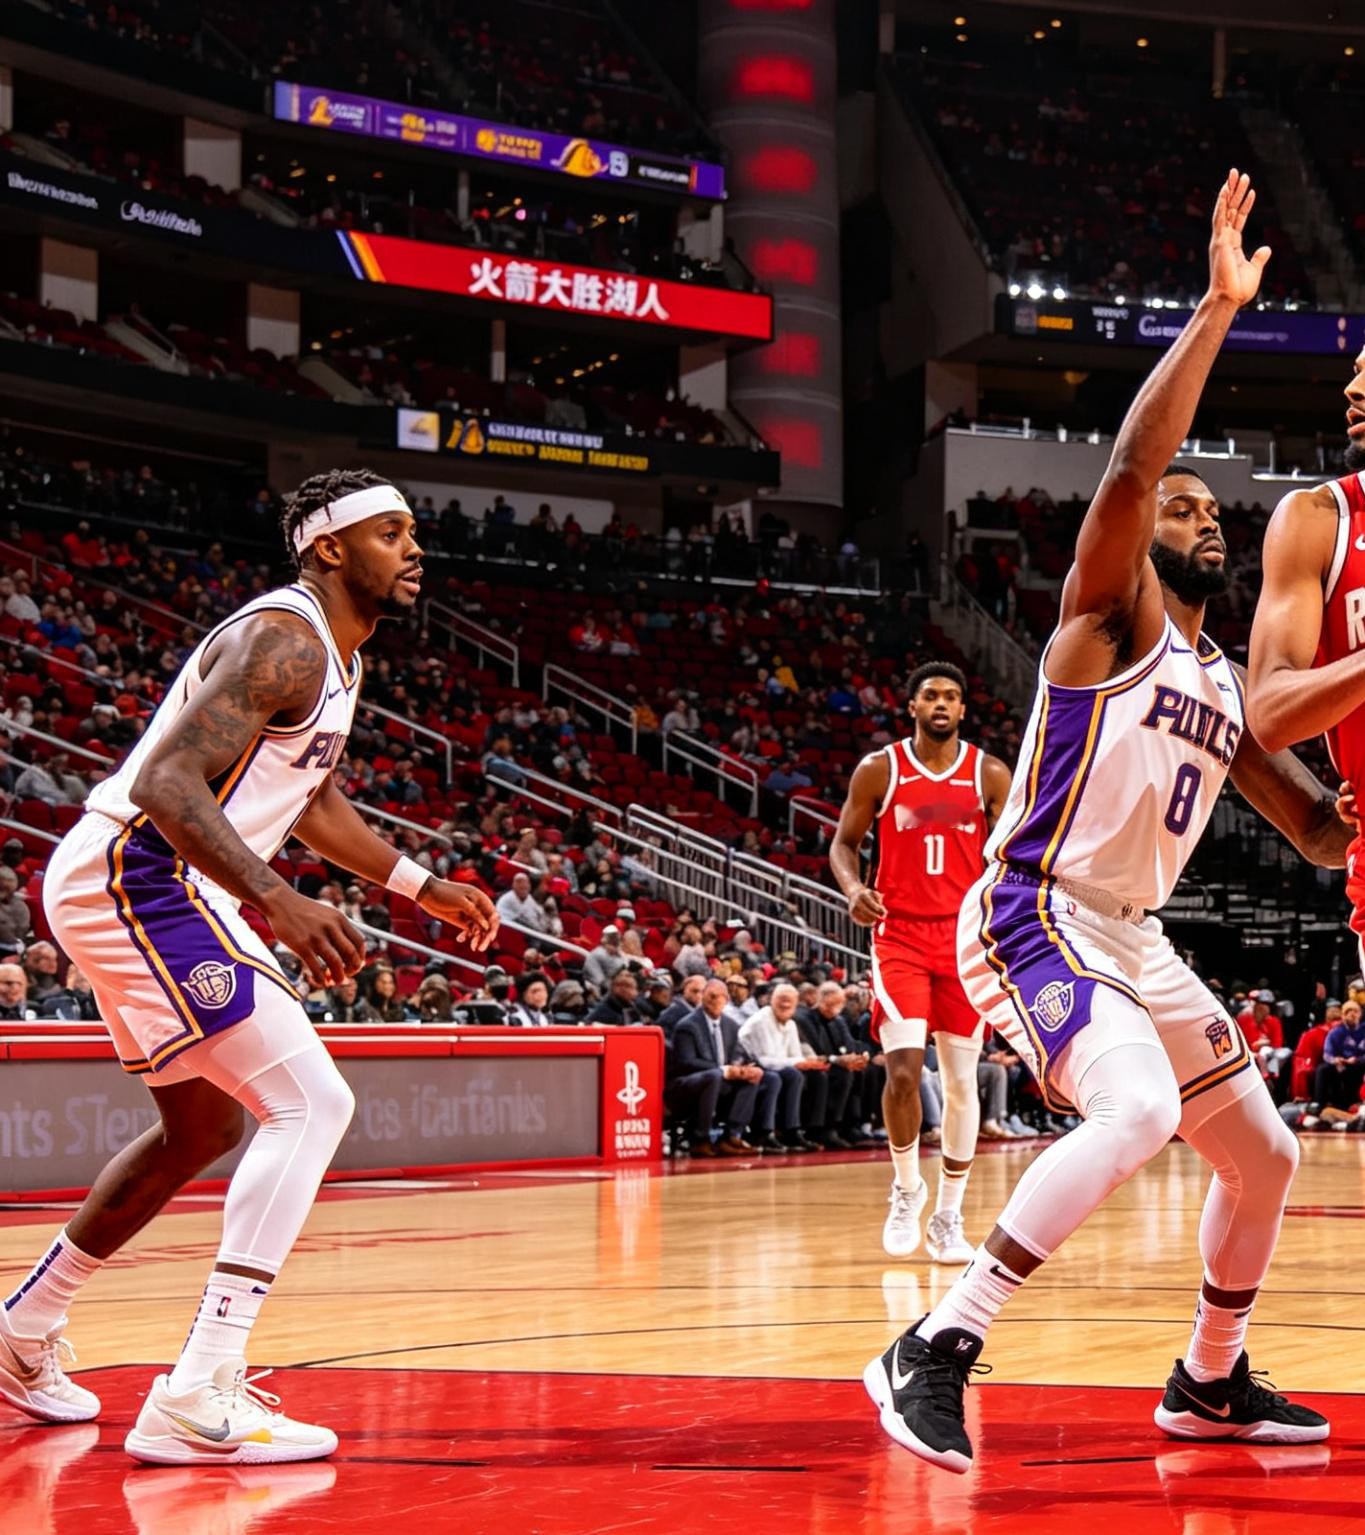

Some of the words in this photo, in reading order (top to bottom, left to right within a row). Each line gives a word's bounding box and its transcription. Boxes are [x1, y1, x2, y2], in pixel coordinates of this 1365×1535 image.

[468, 257, 669, 321] 火箭大胜湖人
[1164, 762, 1202, 836] 8
